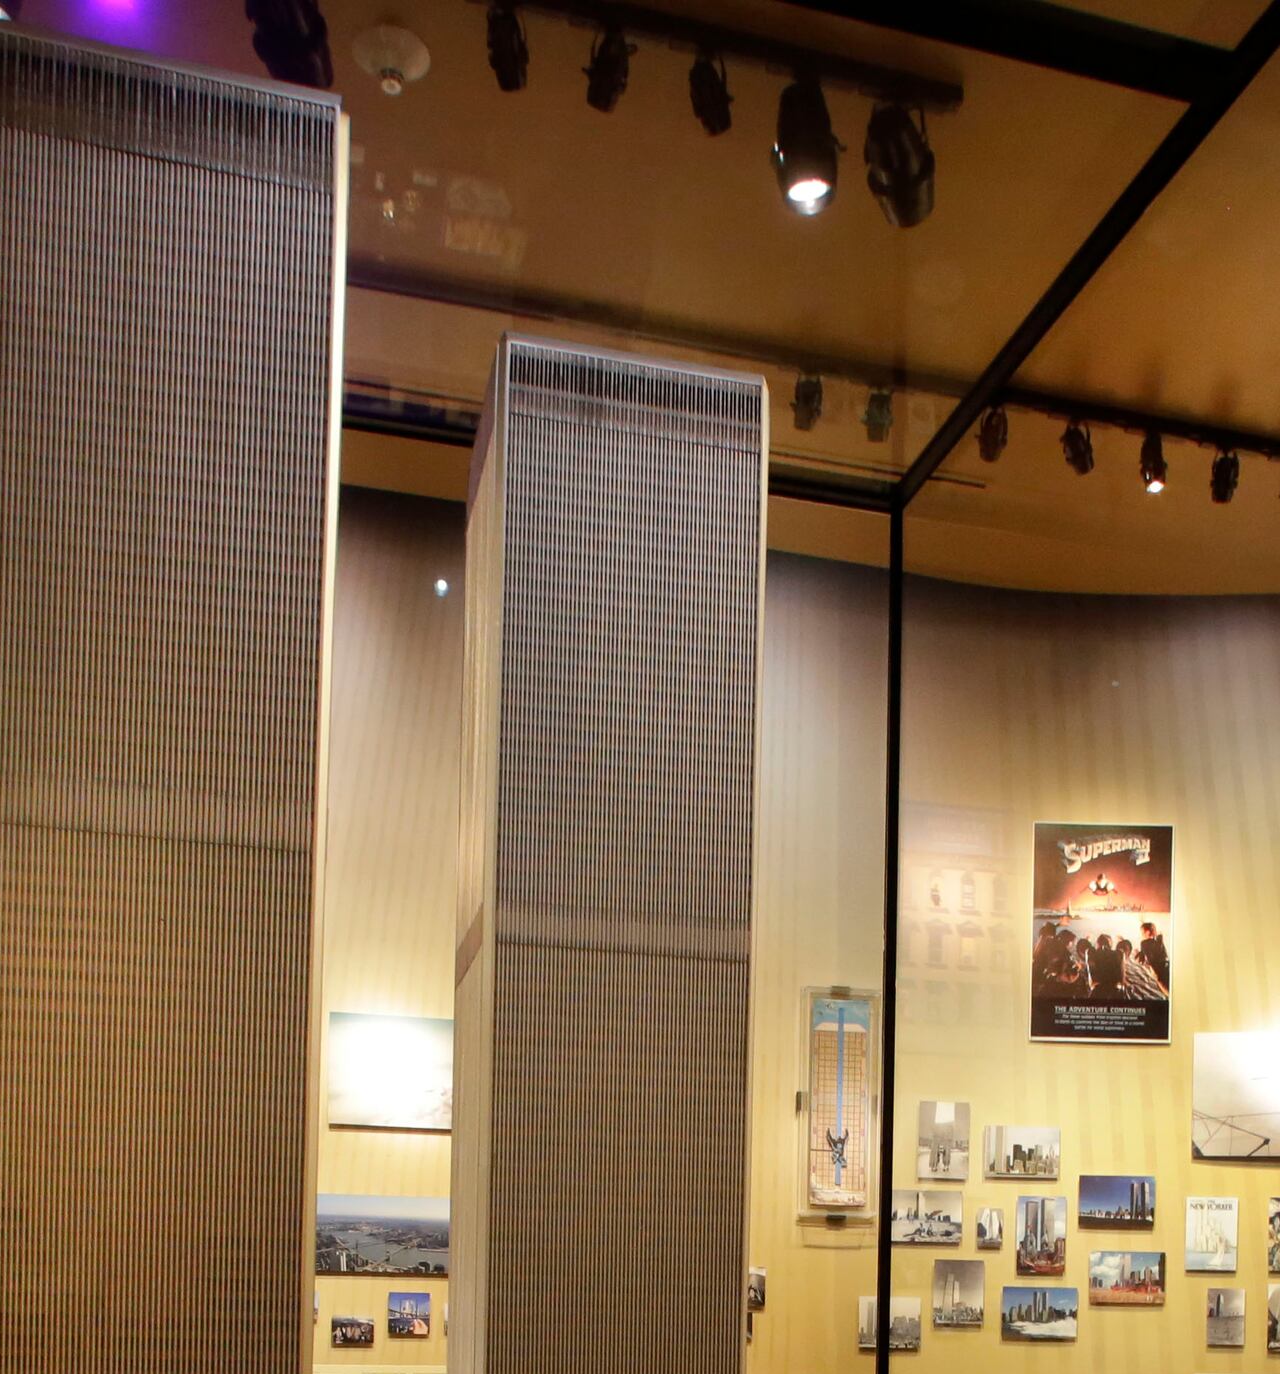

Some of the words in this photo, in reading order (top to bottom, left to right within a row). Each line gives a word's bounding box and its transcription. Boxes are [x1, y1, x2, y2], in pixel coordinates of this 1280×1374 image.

[1062, 838, 1150, 873] SUPERMAN
[1055, 1006, 1067, 1014] THE
[1069, 1006, 1107, 1014] ADVENTURE
[1110, 1007, 1146, 1016] CONTINUES
